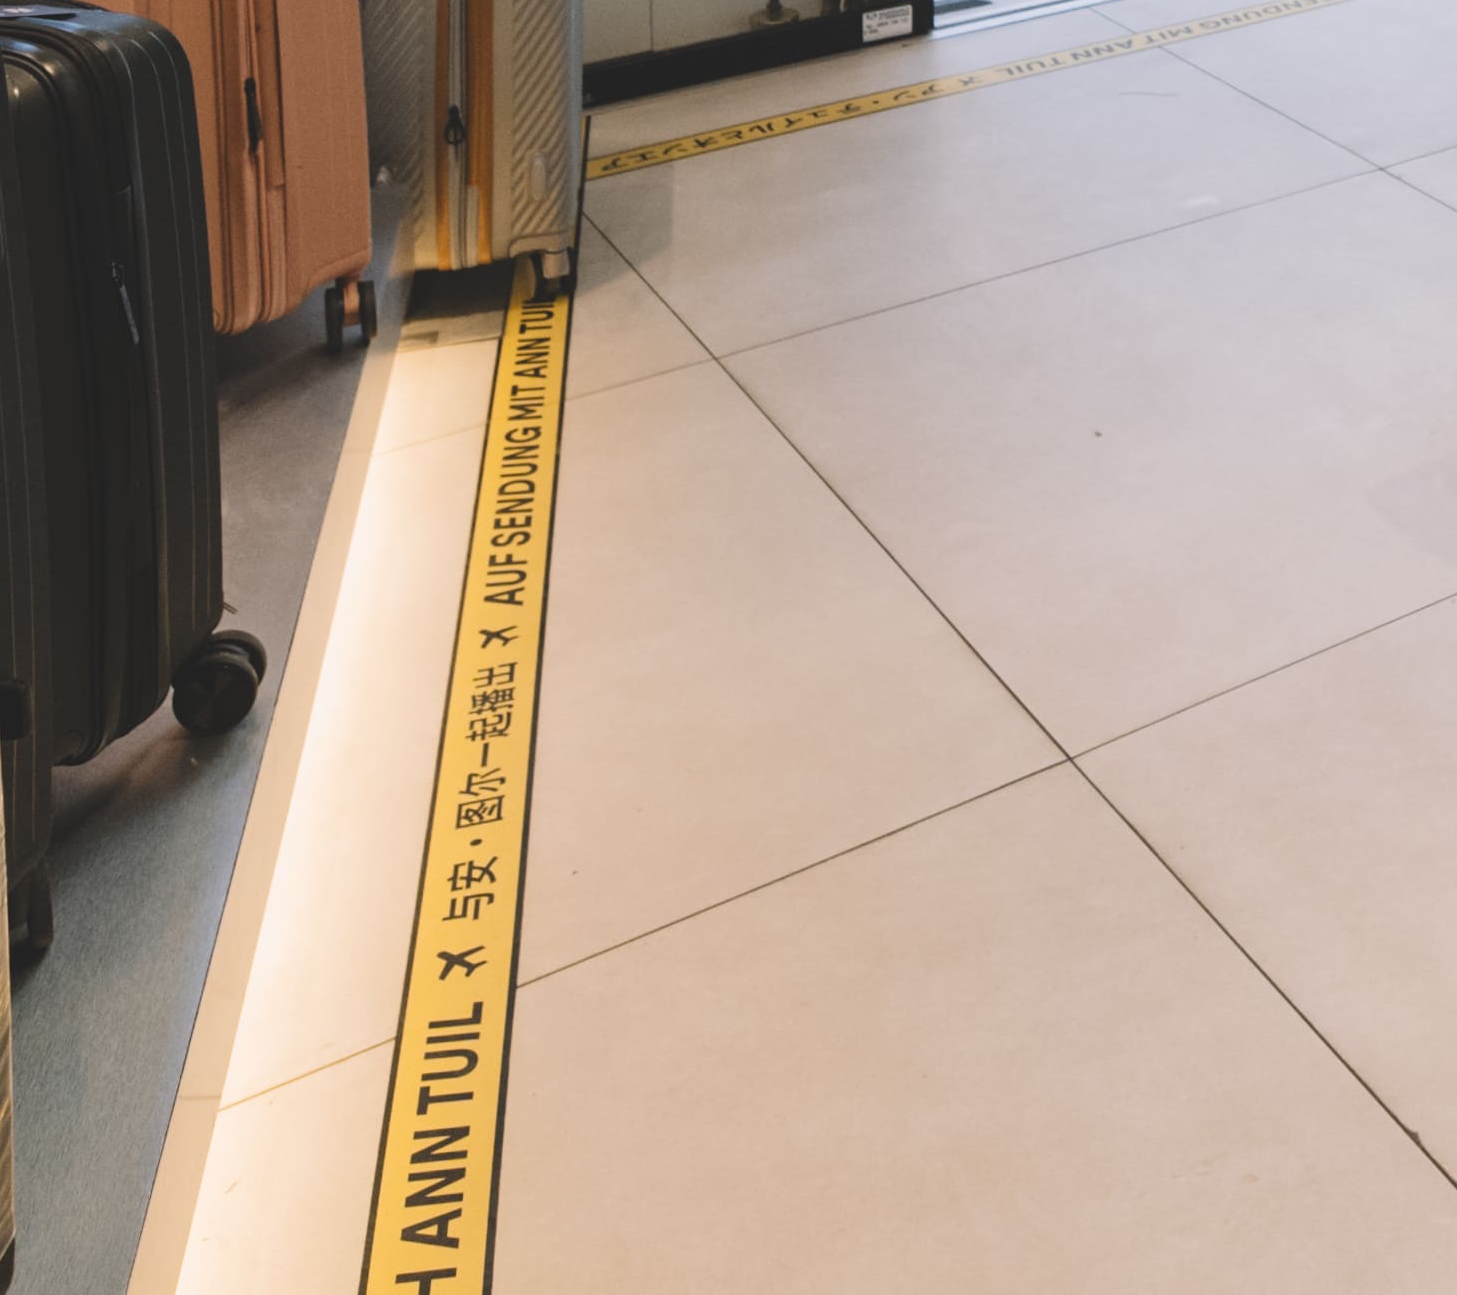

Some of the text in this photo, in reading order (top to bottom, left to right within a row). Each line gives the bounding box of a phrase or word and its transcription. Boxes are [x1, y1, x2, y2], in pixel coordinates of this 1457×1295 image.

[1070, 38, 1135, 63] ANN
[1142, 25, 1194, 47] MIT
[995, 55, 1061, 78] TUIL
[513, 335, 552, 379] ANN
[507, 384, 547, 422] MIT
[491, 424, 543, 549] SENDUNG
[483, 553, 529, 607] AUF
[416, 1000, 484, 1116] TUIL
[400, 1124, 471, 1249] ANN
